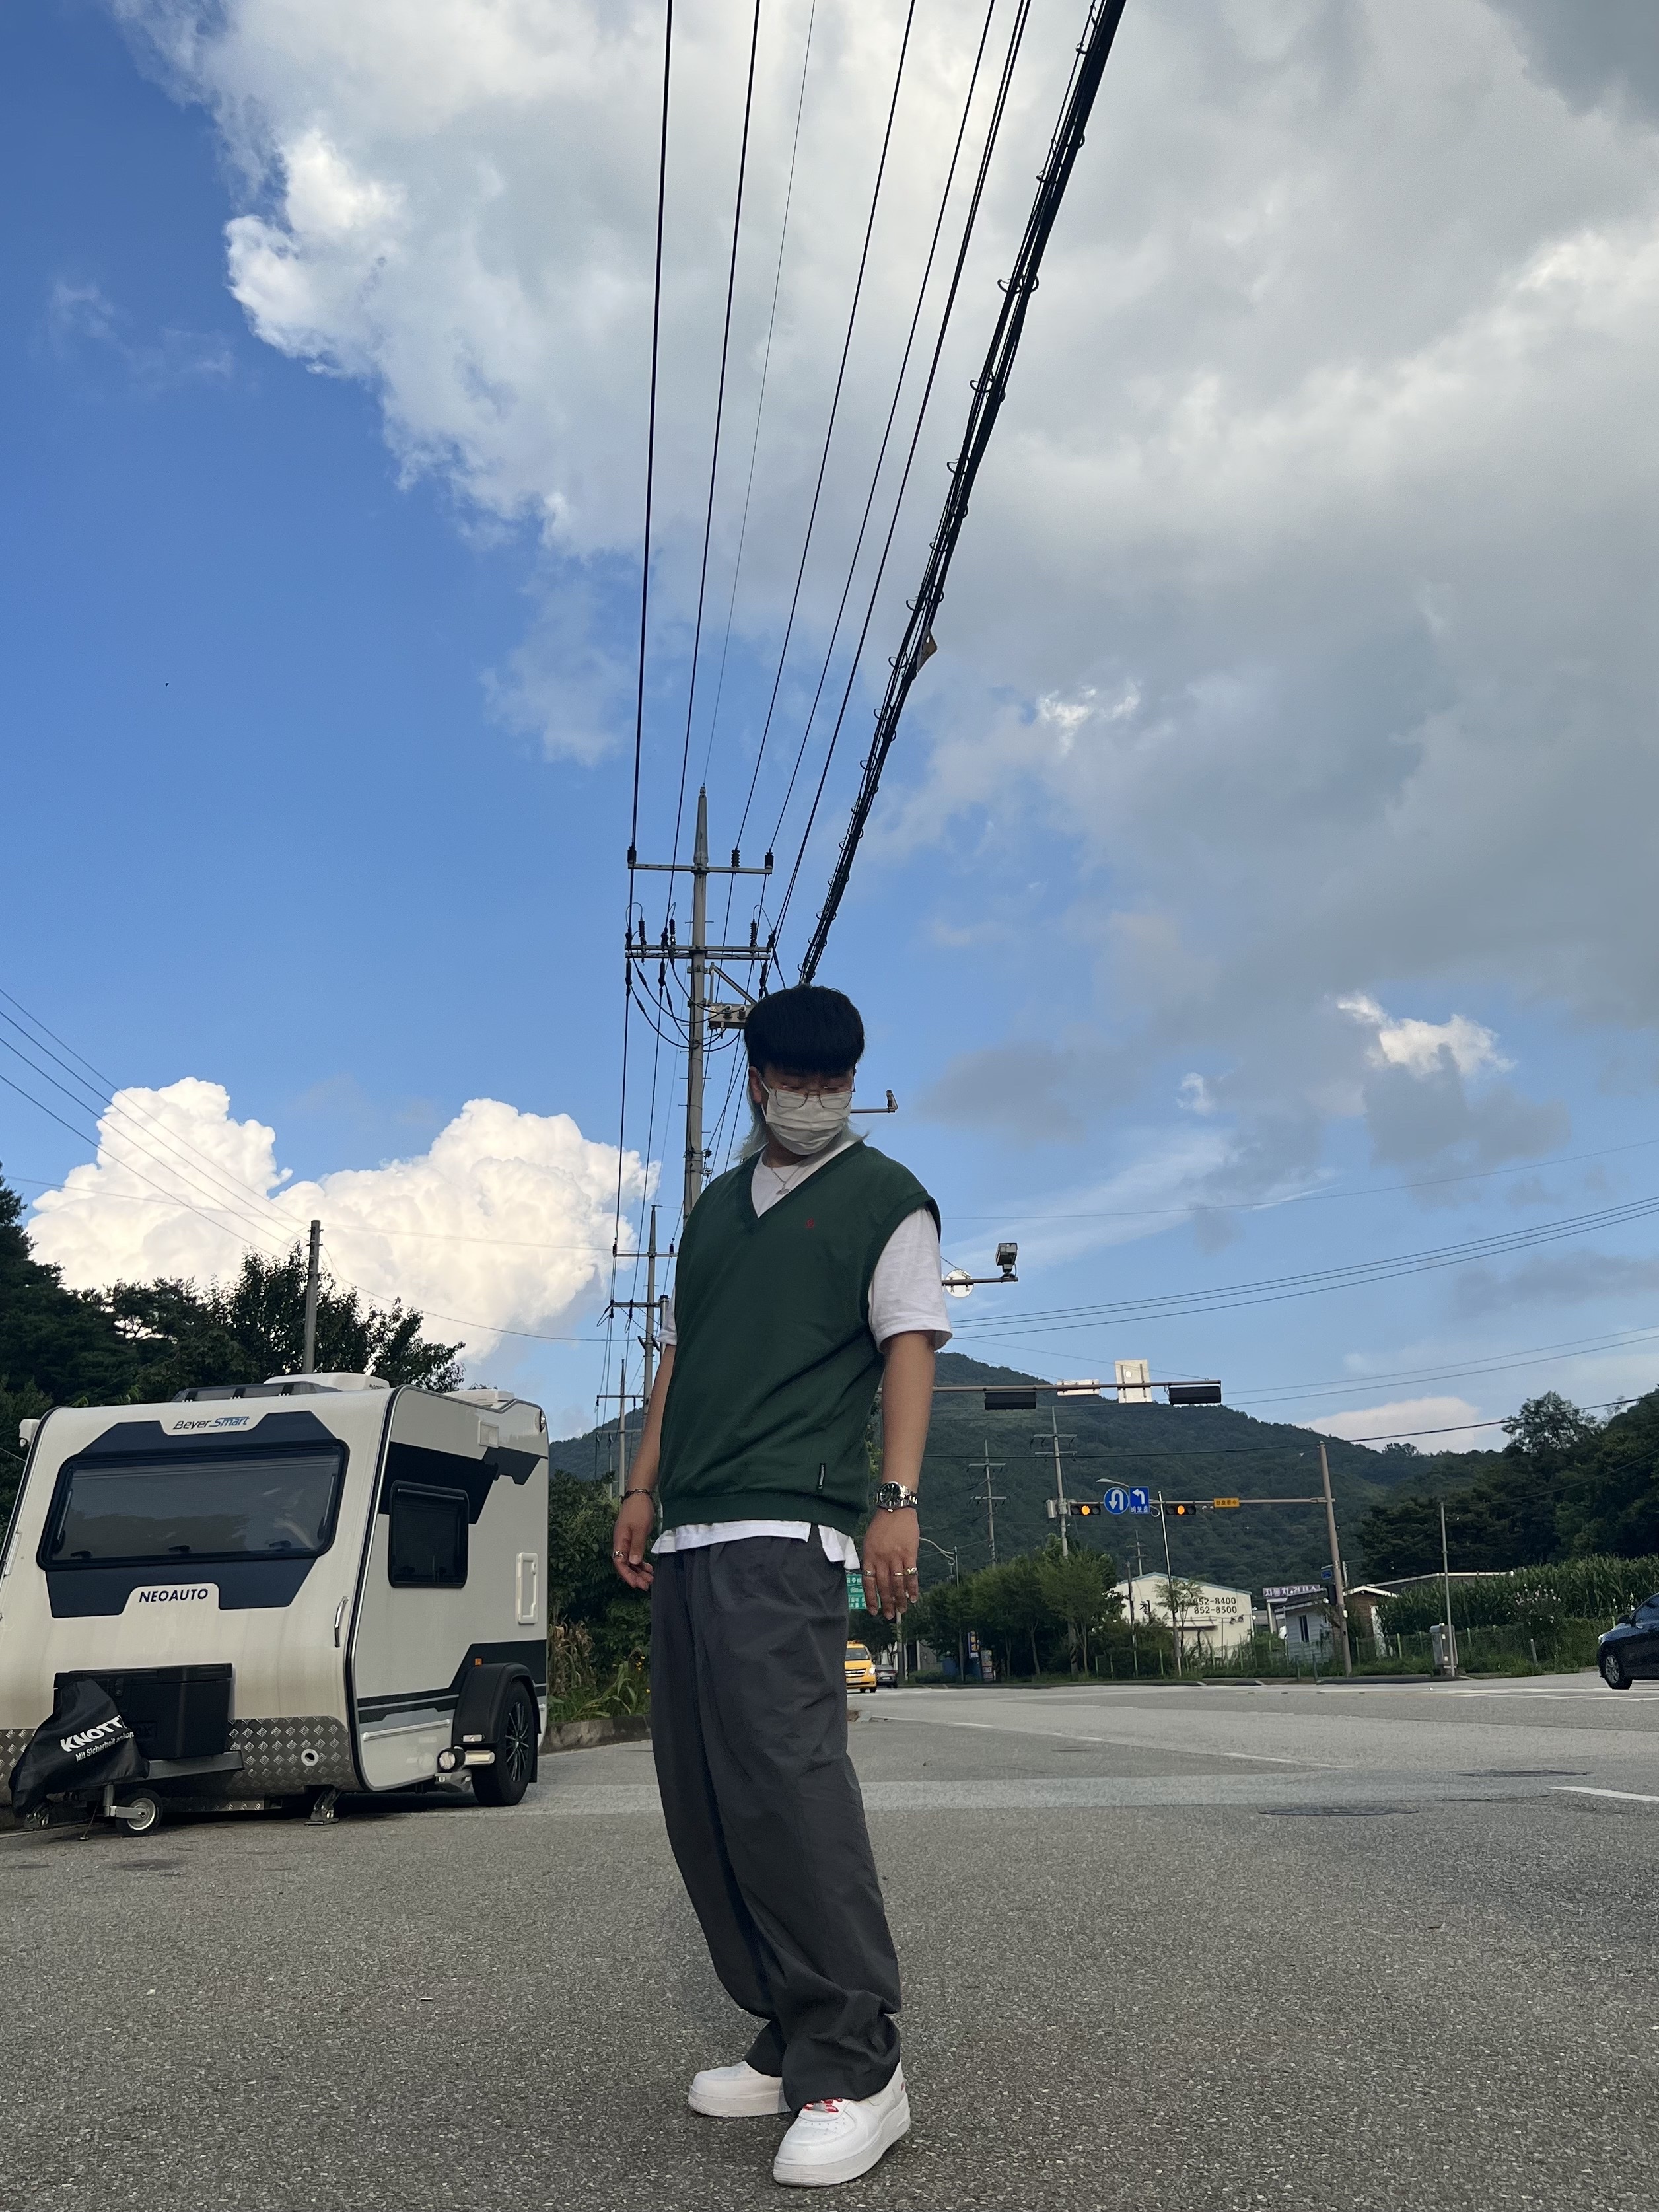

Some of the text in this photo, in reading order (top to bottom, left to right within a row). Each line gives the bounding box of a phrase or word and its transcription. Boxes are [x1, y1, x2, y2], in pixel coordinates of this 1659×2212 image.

[172, 1416, 250, 1430] Beyer Smart
[139, 1588, 209, 1603] NEOAUTO
[1194, 1606, 1238, 1614] 852-8500
[60, 1715, 124, 1752] KNOTT
